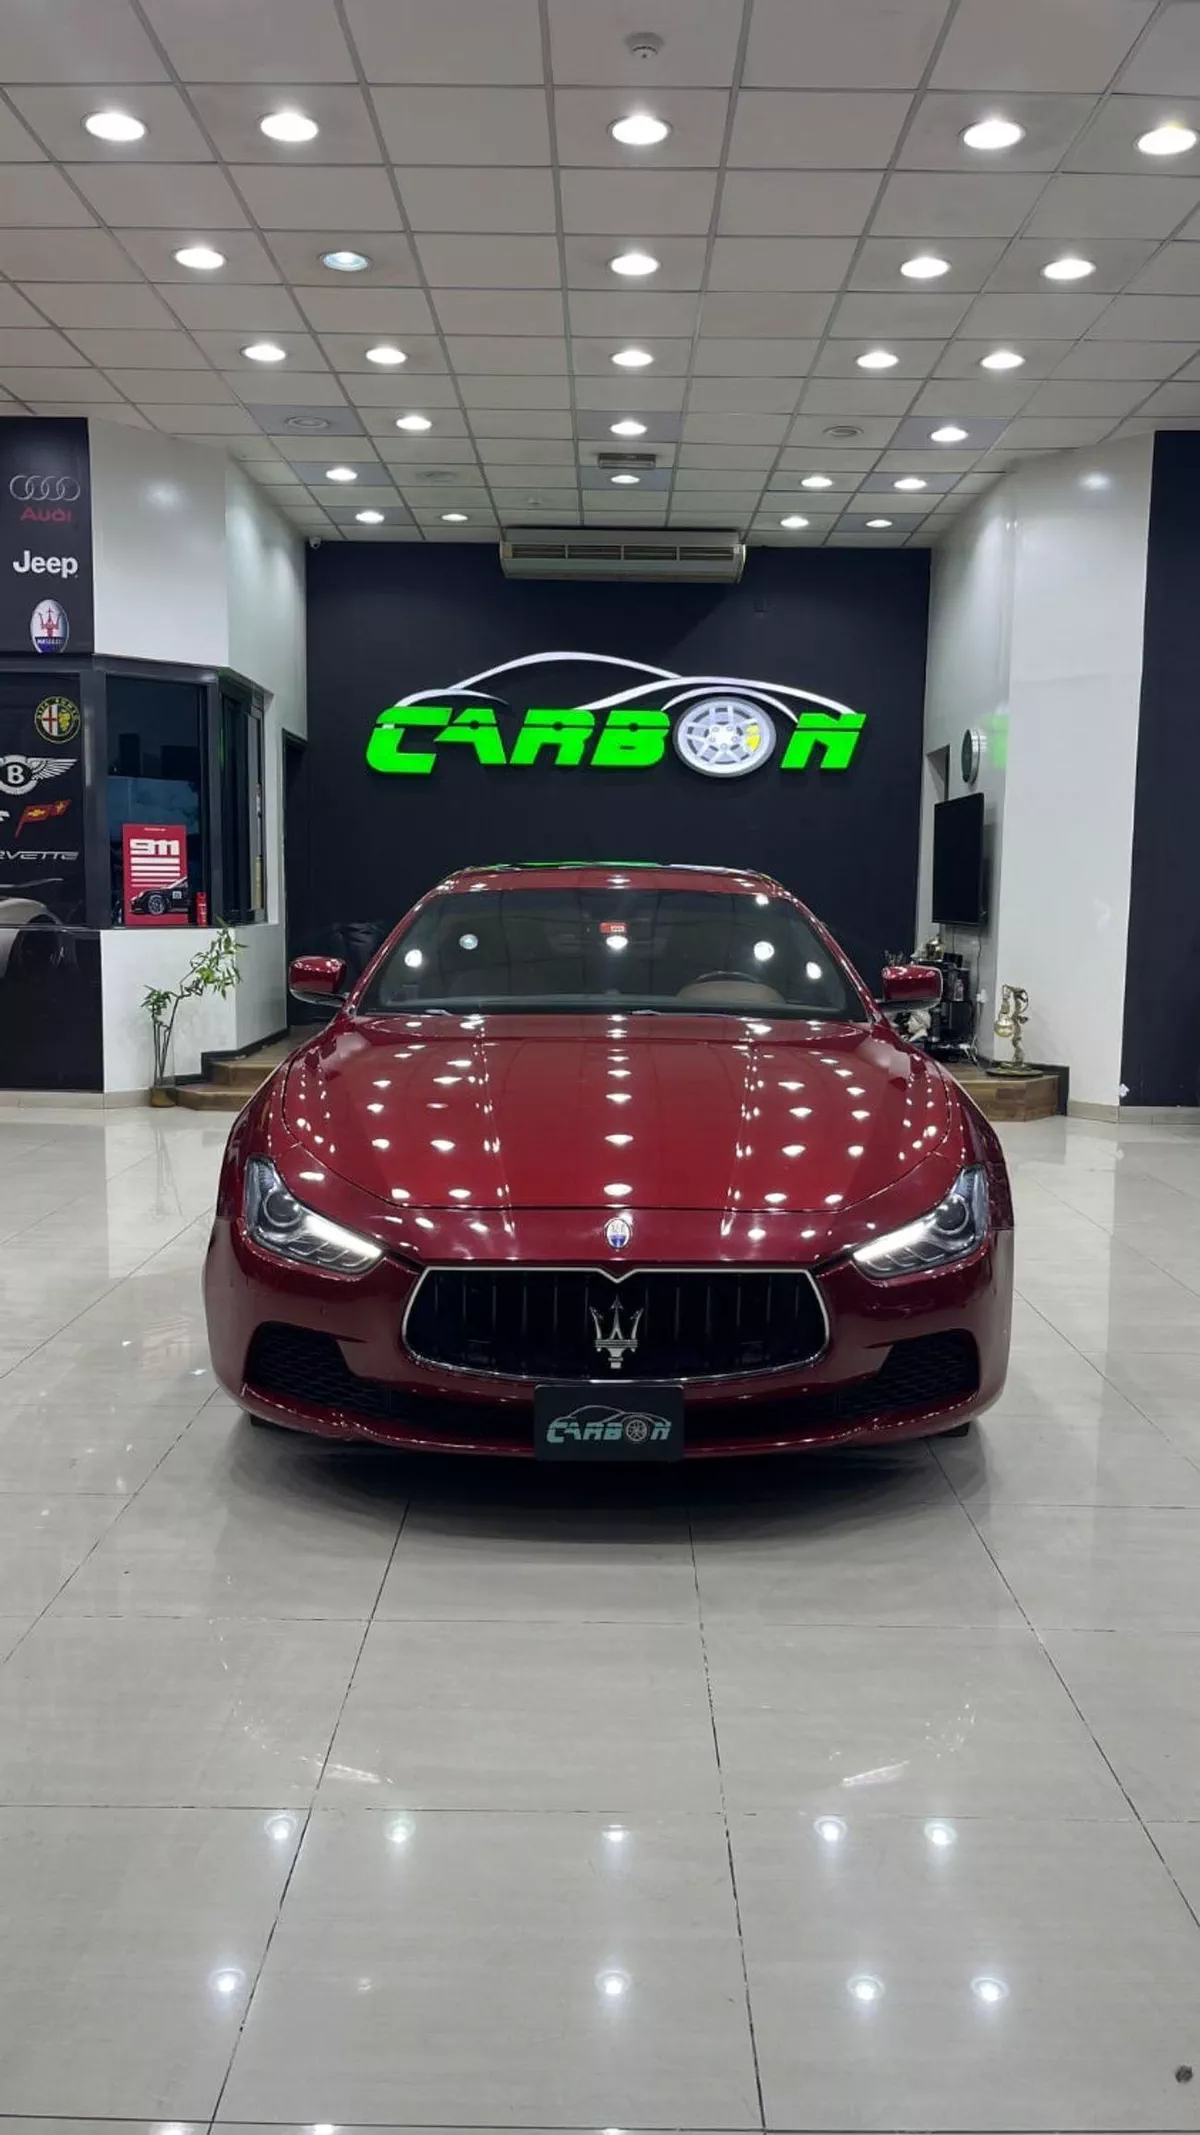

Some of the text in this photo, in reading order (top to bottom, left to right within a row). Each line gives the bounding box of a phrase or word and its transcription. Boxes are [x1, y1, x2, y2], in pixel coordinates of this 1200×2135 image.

[20, 507, 73, 522] Audi
[13, 550, 79, 578] Jeep
[366, 697, 867, 775] CARBON
[7, 764, 25, 784] B
[130, 839, 180, 855] 911
[546, 1419, 672, 1443] CARBON
